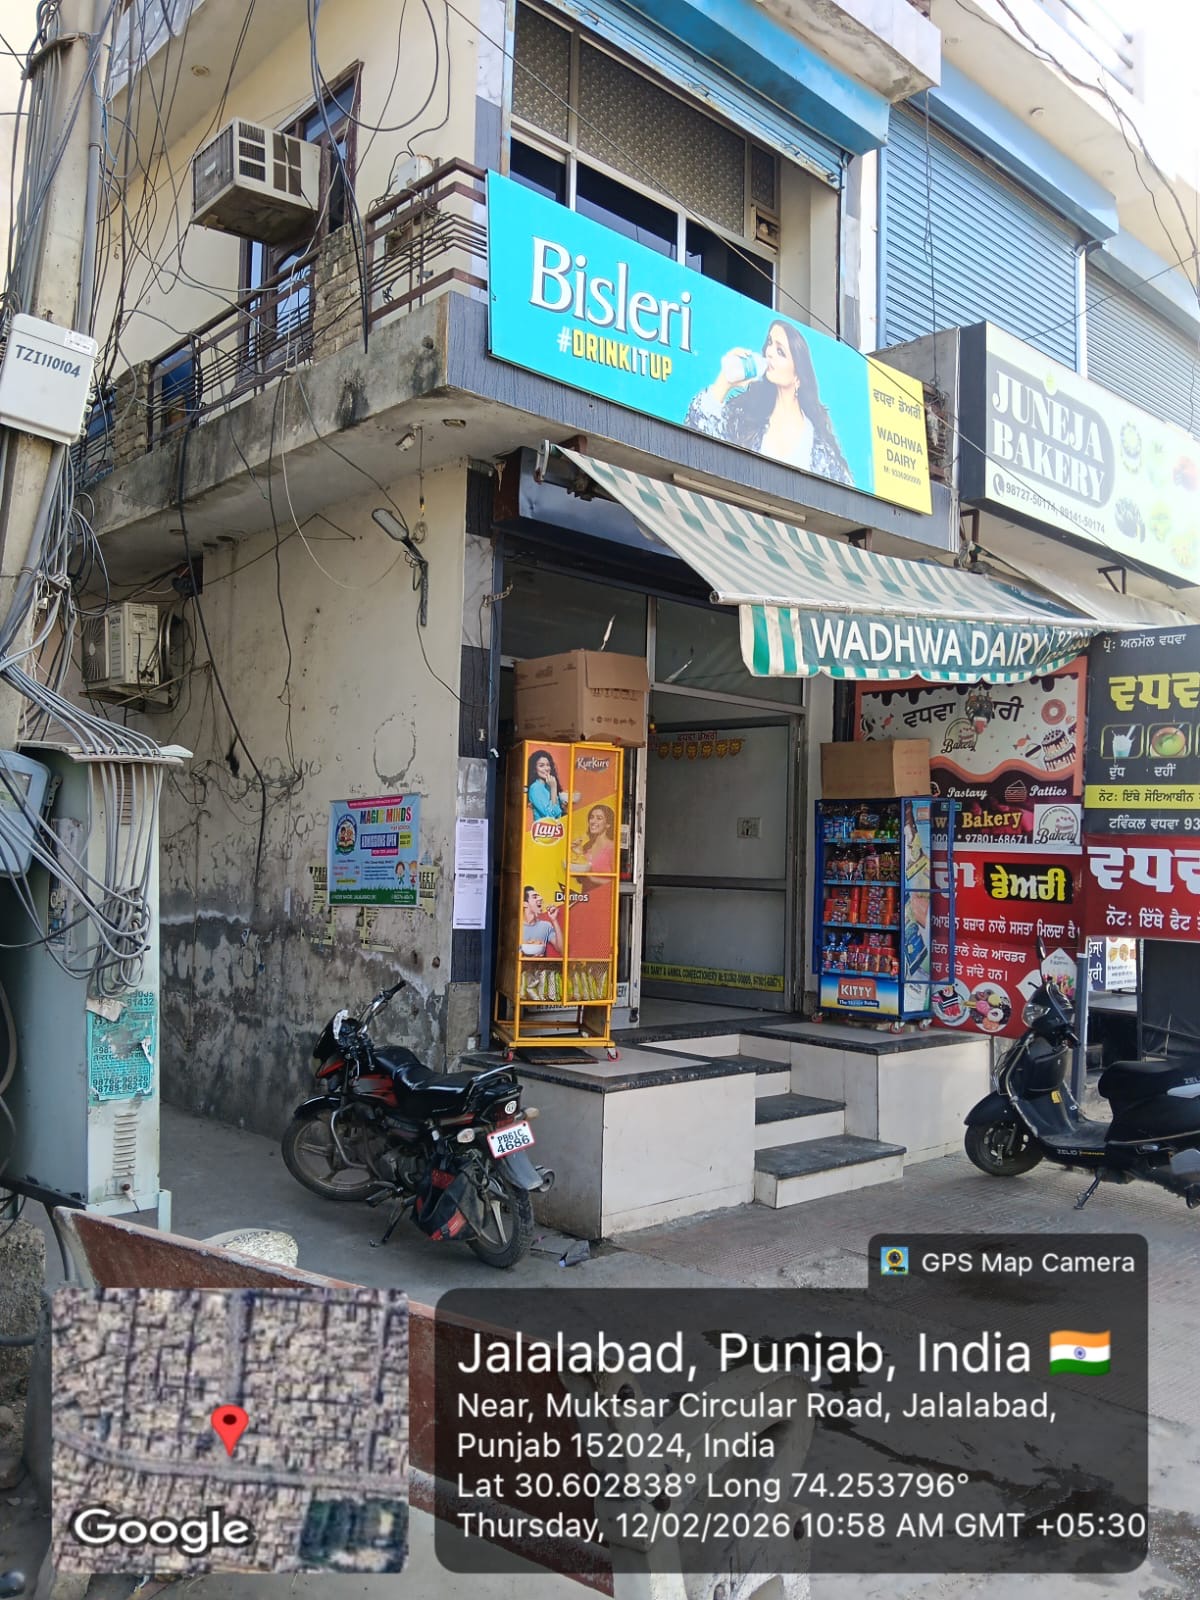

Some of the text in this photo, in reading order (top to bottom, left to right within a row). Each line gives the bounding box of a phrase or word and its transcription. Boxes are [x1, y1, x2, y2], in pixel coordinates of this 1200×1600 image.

[529, 235, 692, 353] Bisleri
[15, 344, 81, 378] TZI110104
[557, 326, 673, 382] #DRINKITUP
[992, 370, 1105, 464] JUNEJA
[876, 425, 923, 455] WADHWA
[886, 448, 917, 471] DAIRY
[992, 418, 1106, 504] BAKERY
[810, 617, 963, 666] WADHWA
[969, 630, 1048, 667] DAIRY
[902, 702, 957, 729] ਵਧਵਾ
[946, 786, 988, 800] Pastary
[1028, 784, 1068, 797] Patties
[359, 809, 385, 825] MAGIC
[386, 806, 412, 823] MINDS
[961, 810, 1023, 830] Bakery
[1034, 827, 1078, 846] Bakery
[989, 864, 1067, 901] ਡੇਅਰੀ
[840, 984, 873, 998] KITTY
[497, 1128, 525, 1145] PB61C
[497, 1134, 530, 1153] 4686
